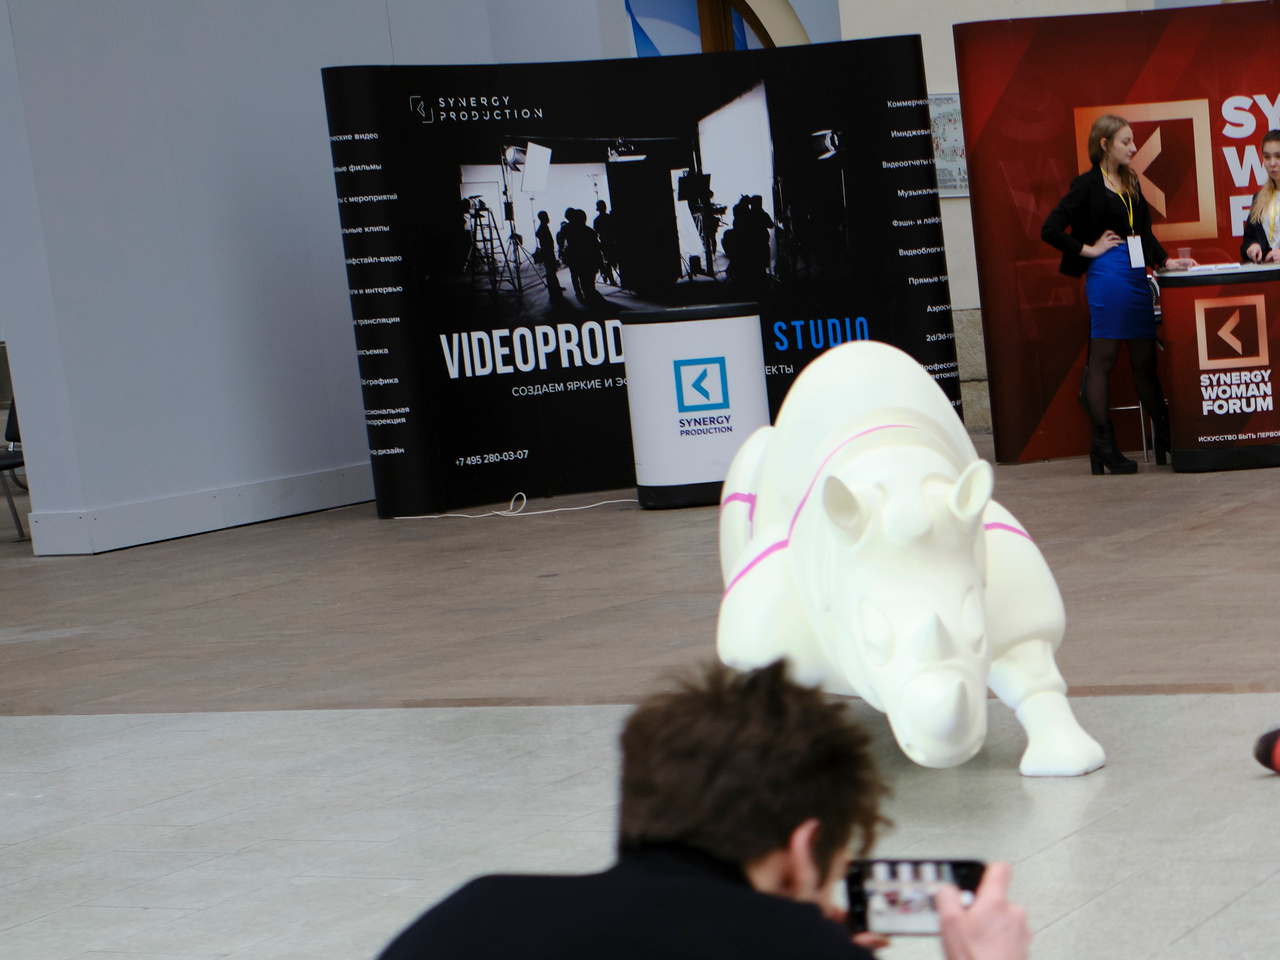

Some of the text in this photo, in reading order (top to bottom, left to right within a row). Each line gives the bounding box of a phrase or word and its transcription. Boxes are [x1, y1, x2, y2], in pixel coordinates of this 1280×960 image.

[439, 96, 510, 107] SYNERGY
[440, 108, 543, 121] PRODUCTION
[348, 164, 382, 173] фильмы
[348, 193, 398, 203] мероприятий
[364, 224, 390, 233] клипы
[908, 277, 939, 286] Прямые
[365, 285, 403, 294] интервью
[358, 317, 400, 326] трансляции
[440, 316, 869, 379] VIDEOPROD STUDIO
[1200, 369, 1271, 386] SYNERGY
[512, 382, 564, 396] СОЗДАЕМ
[567, 379, 602, 391] ЯРКИЕ
[604, 378, 613, 388] И
[1201, 382, 1272, 400] WOMAN
[1202, 396, 1274, 416] FORUM
[679, 415, 732, 428] SYNERGY
[680, 426, 733, 437] PRODUCTION
[1198, 434, 1237, 443] ИСКУССТВО
[1238, 432, 1256, 441] БЫТЬ
[455, 450, 529, 467] +7 495 280-03-07
